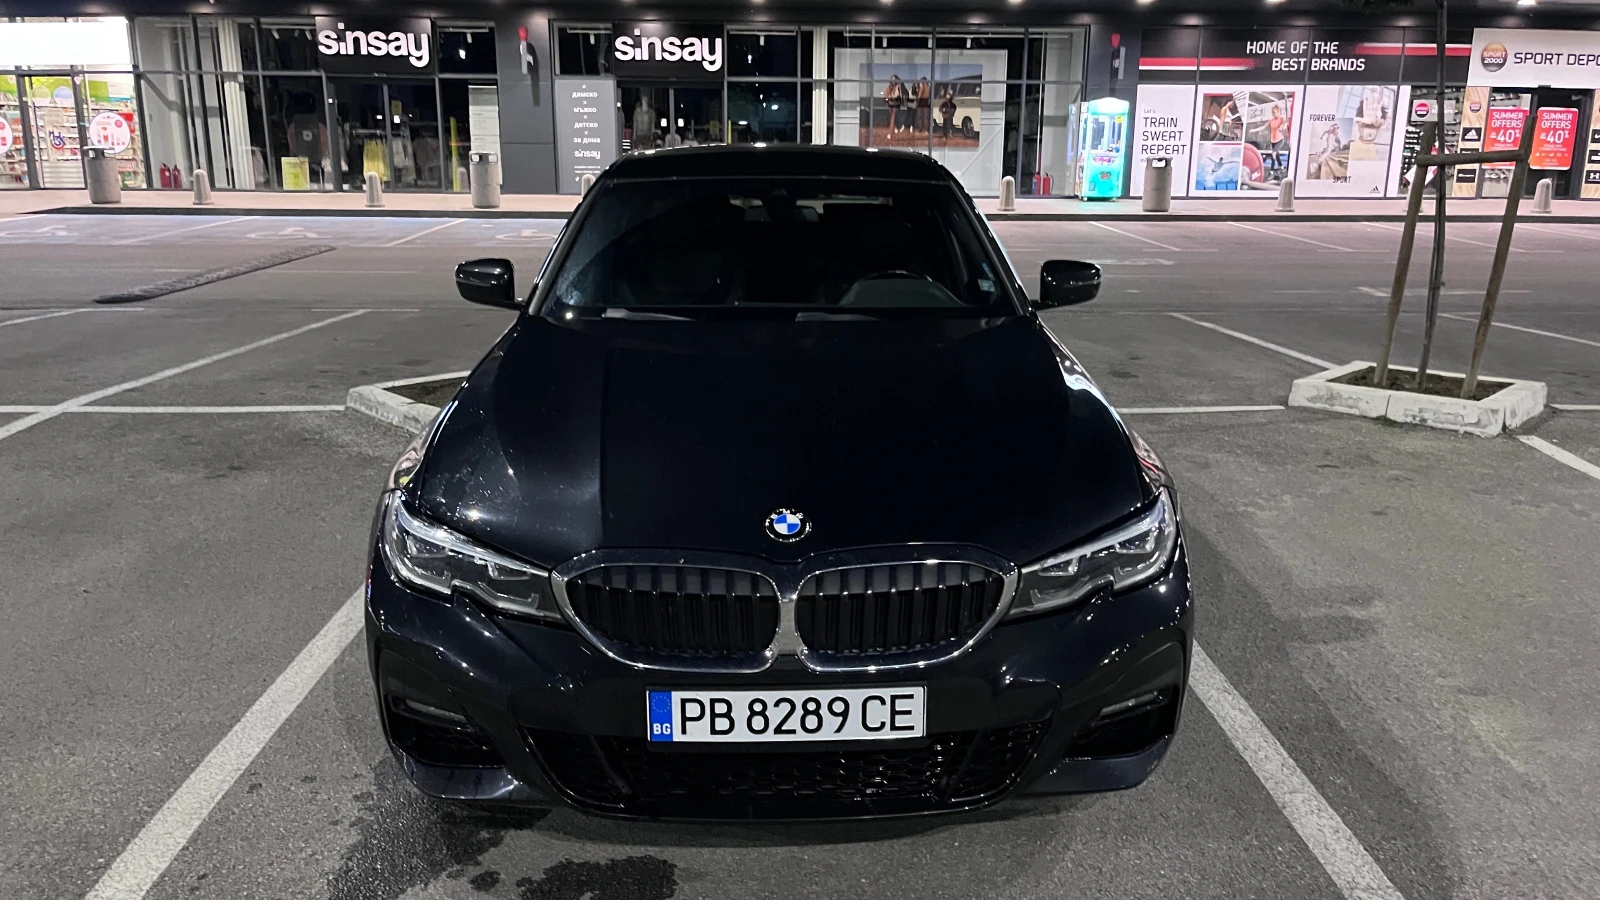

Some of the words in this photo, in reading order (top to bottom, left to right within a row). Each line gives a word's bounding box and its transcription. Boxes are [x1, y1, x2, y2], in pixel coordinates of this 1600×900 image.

[318, 22, 430, 67] sinsay
[614, 28, 722, 72] sinsay
[1246, 41, 1286, 54] HOME
[1290, 41, 1308, 54] OF
[1314, 42, 1339, 54] THE
[1513, 52, 1563, 65] SPORT
[1272, 58, 1307, 71] BEST
[1311, 58, 1365, 71] BRANDS
[1309, 114, 1336, 122] FOREVER
[1542, 112, 1572, 120] SUMMER
[1143, 117, 1178, 128] TRAIN
[1491, 119, 1522, 128] OFFERS
[1541, 120, 1571, 129] OFFERS
[1142, 130, 1184, 142] SWEAT
[574, 148, 600, 159] sinsay
[1141, 144, 1187, 155] REPEAT
[1332, 176, 1352, 184] SPORT
[680, 697, 735, 735] PB
[746, 696, 850, 735] 8289
[860, 693, 915, 733] CE
[652, 723, 671, 735] BG
